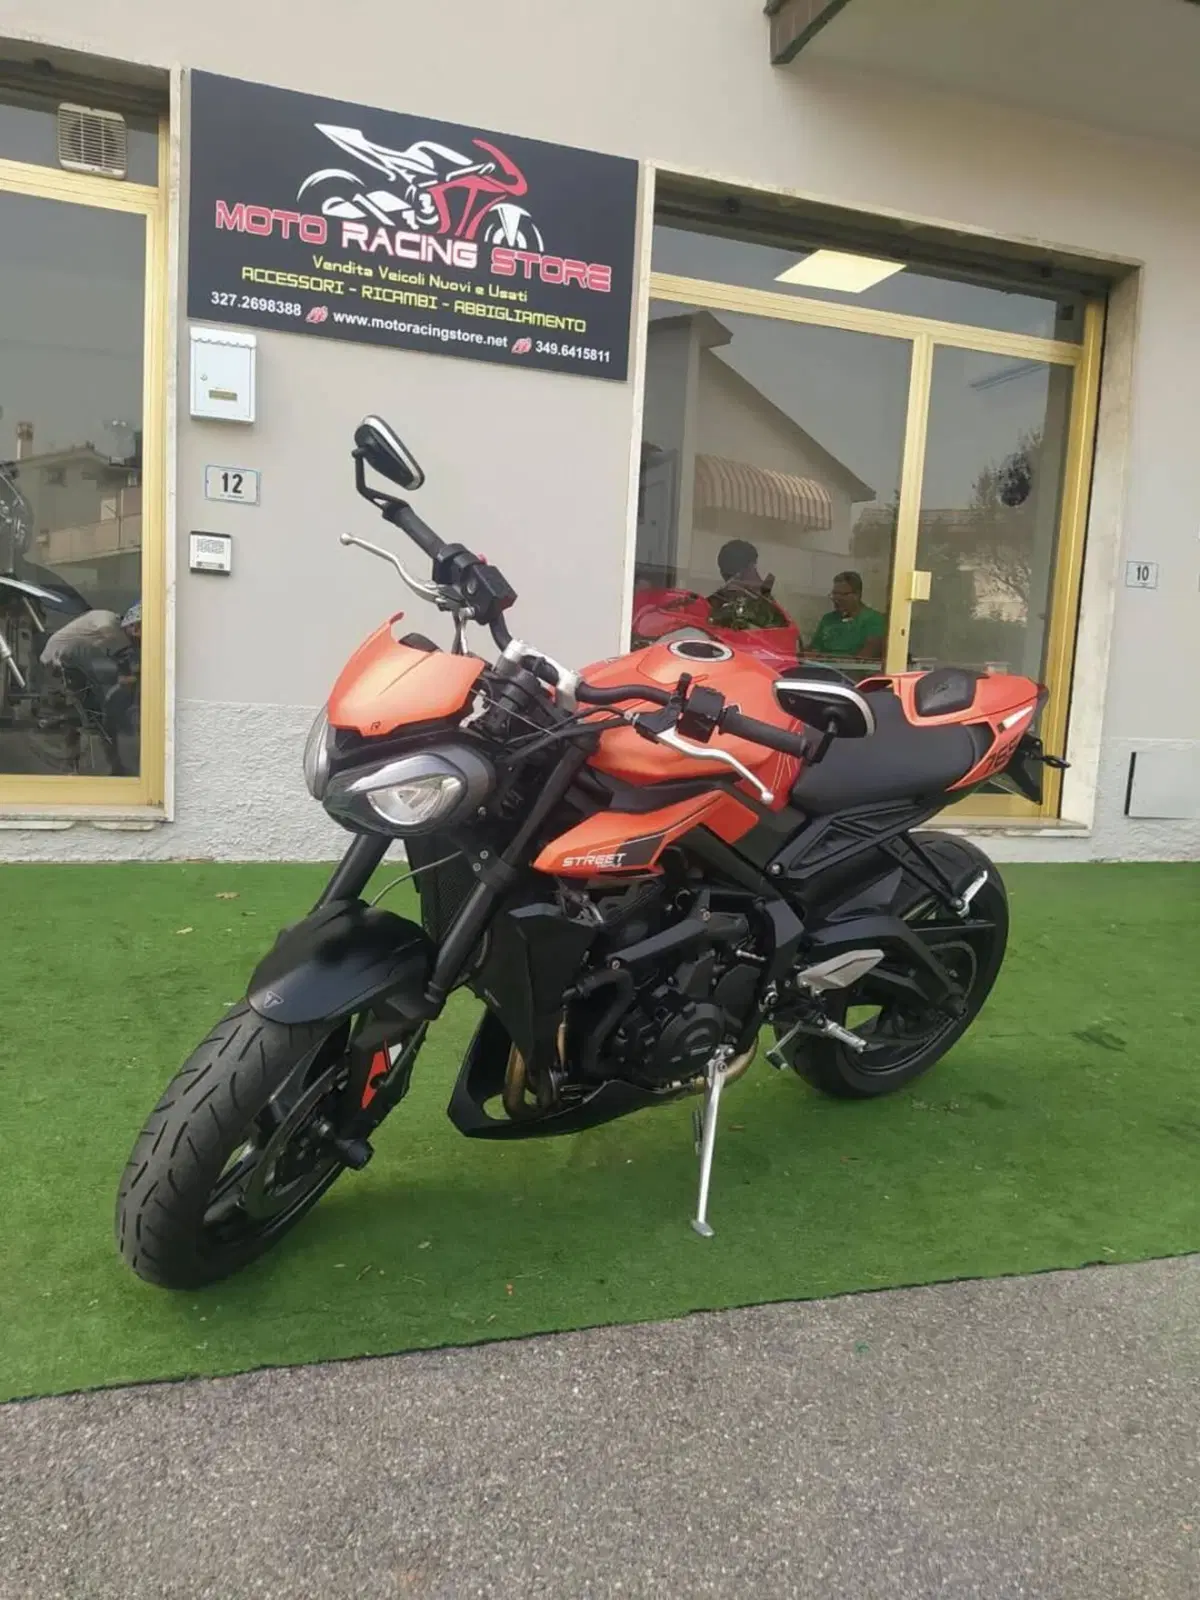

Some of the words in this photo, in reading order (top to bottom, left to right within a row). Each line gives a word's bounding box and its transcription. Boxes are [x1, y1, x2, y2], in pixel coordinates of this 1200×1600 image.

[215, 199, 327, 245] MOTO
[341, 221, 478, 269] RACING
[491, 247, 611, 292] STORE
[241, 266, 345, 295] ACCESSORI
[361, 284, 438, 309] RICAMBI
[454, 300, 587, 333] ABBIGLIAMENTO
[312, 254, 373, 277] Vendita
[378, 265, 425, 286] Veicoli
[429, 275, 471, 294] Nuovi
[475, 285, 484, 295] e
[488, 284, 528, 303] Usati
[211, 291, 301, 316] 327.2698388
[333, 311, 508, 348] www.motoracingstore.net
[535, 340, 610, 363] 349.6415811
[222, 472, 243, 494] 12
[1137, 565, 1149, 581] 10
[562, 853, 627, 867] STREET
